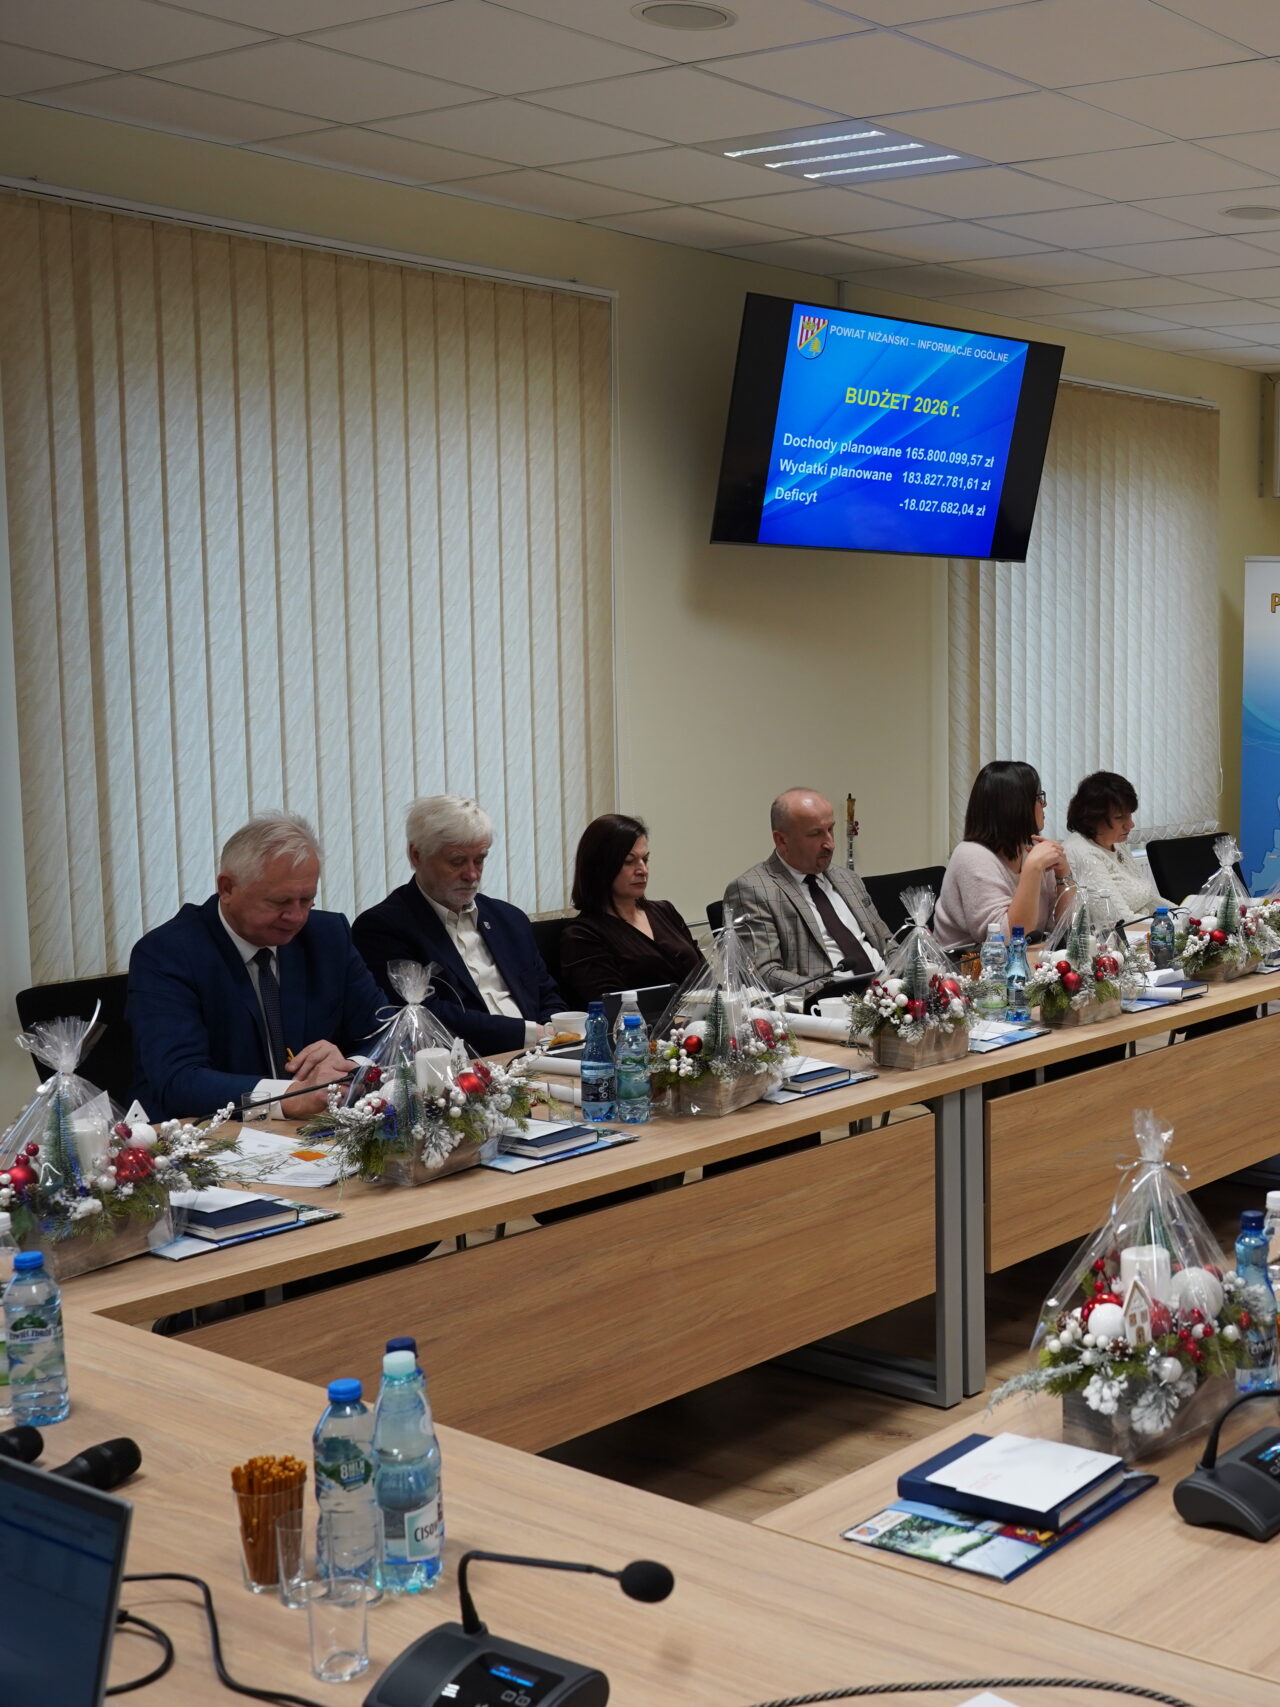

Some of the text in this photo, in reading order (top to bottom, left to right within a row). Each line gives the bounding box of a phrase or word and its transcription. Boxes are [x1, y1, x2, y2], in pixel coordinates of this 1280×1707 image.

[829, 325, 865, 339] POWIAT
[867, 329, 909, 346] NIŻAŃSKI
[917, 339, 972, 357] INFORMACJE
[973, 347, 1009, 363] OGÓLNE
[845, 387, 961, 417] BUDŻET 2026 r.
[783, 433, 995, 468] Dochody planowane 165.800.099,57 zł
[779, 458, 991, 491] Wydatki planowane 183.827.781,61 zł
[774, 487, 986, 518] Deficyt -18.027.682,04 zł
